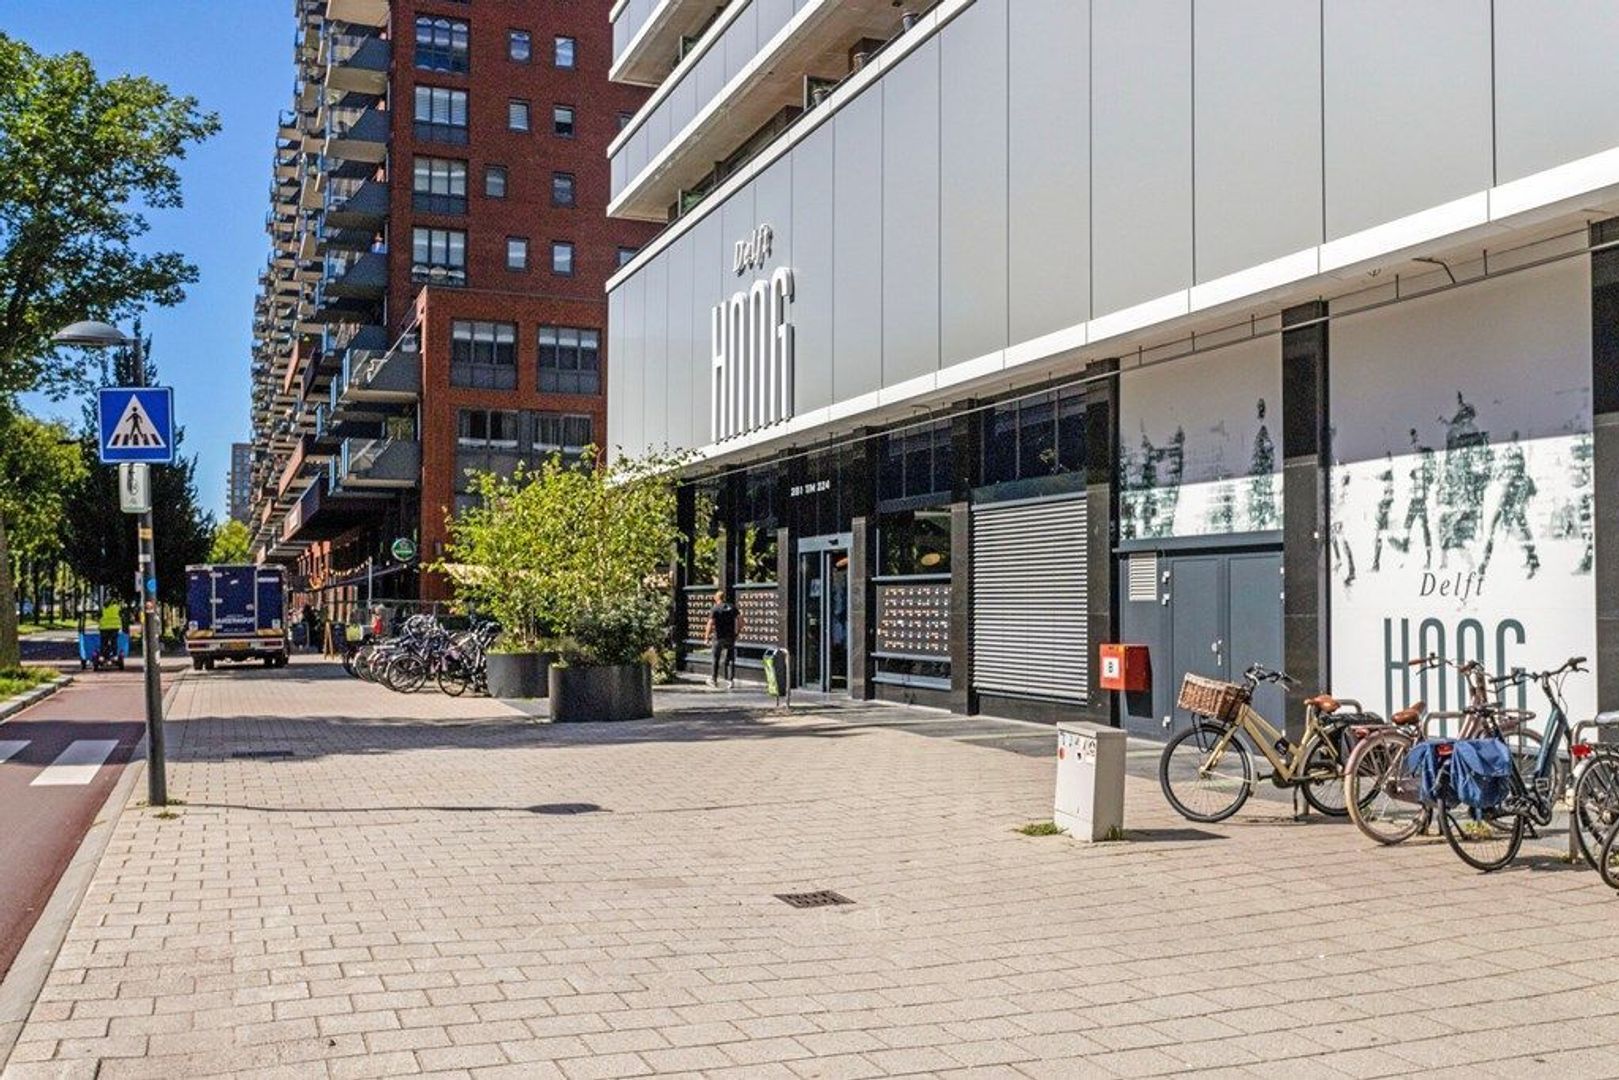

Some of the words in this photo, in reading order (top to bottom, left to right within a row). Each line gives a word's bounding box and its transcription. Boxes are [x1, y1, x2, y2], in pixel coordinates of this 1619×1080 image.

[733, 223, 772, 273] Delft
[711, 267, 794, 443] HOOG
[1419, 572, 1486, 601] Delft
[1384, 617, 1526, 746] HOOG
